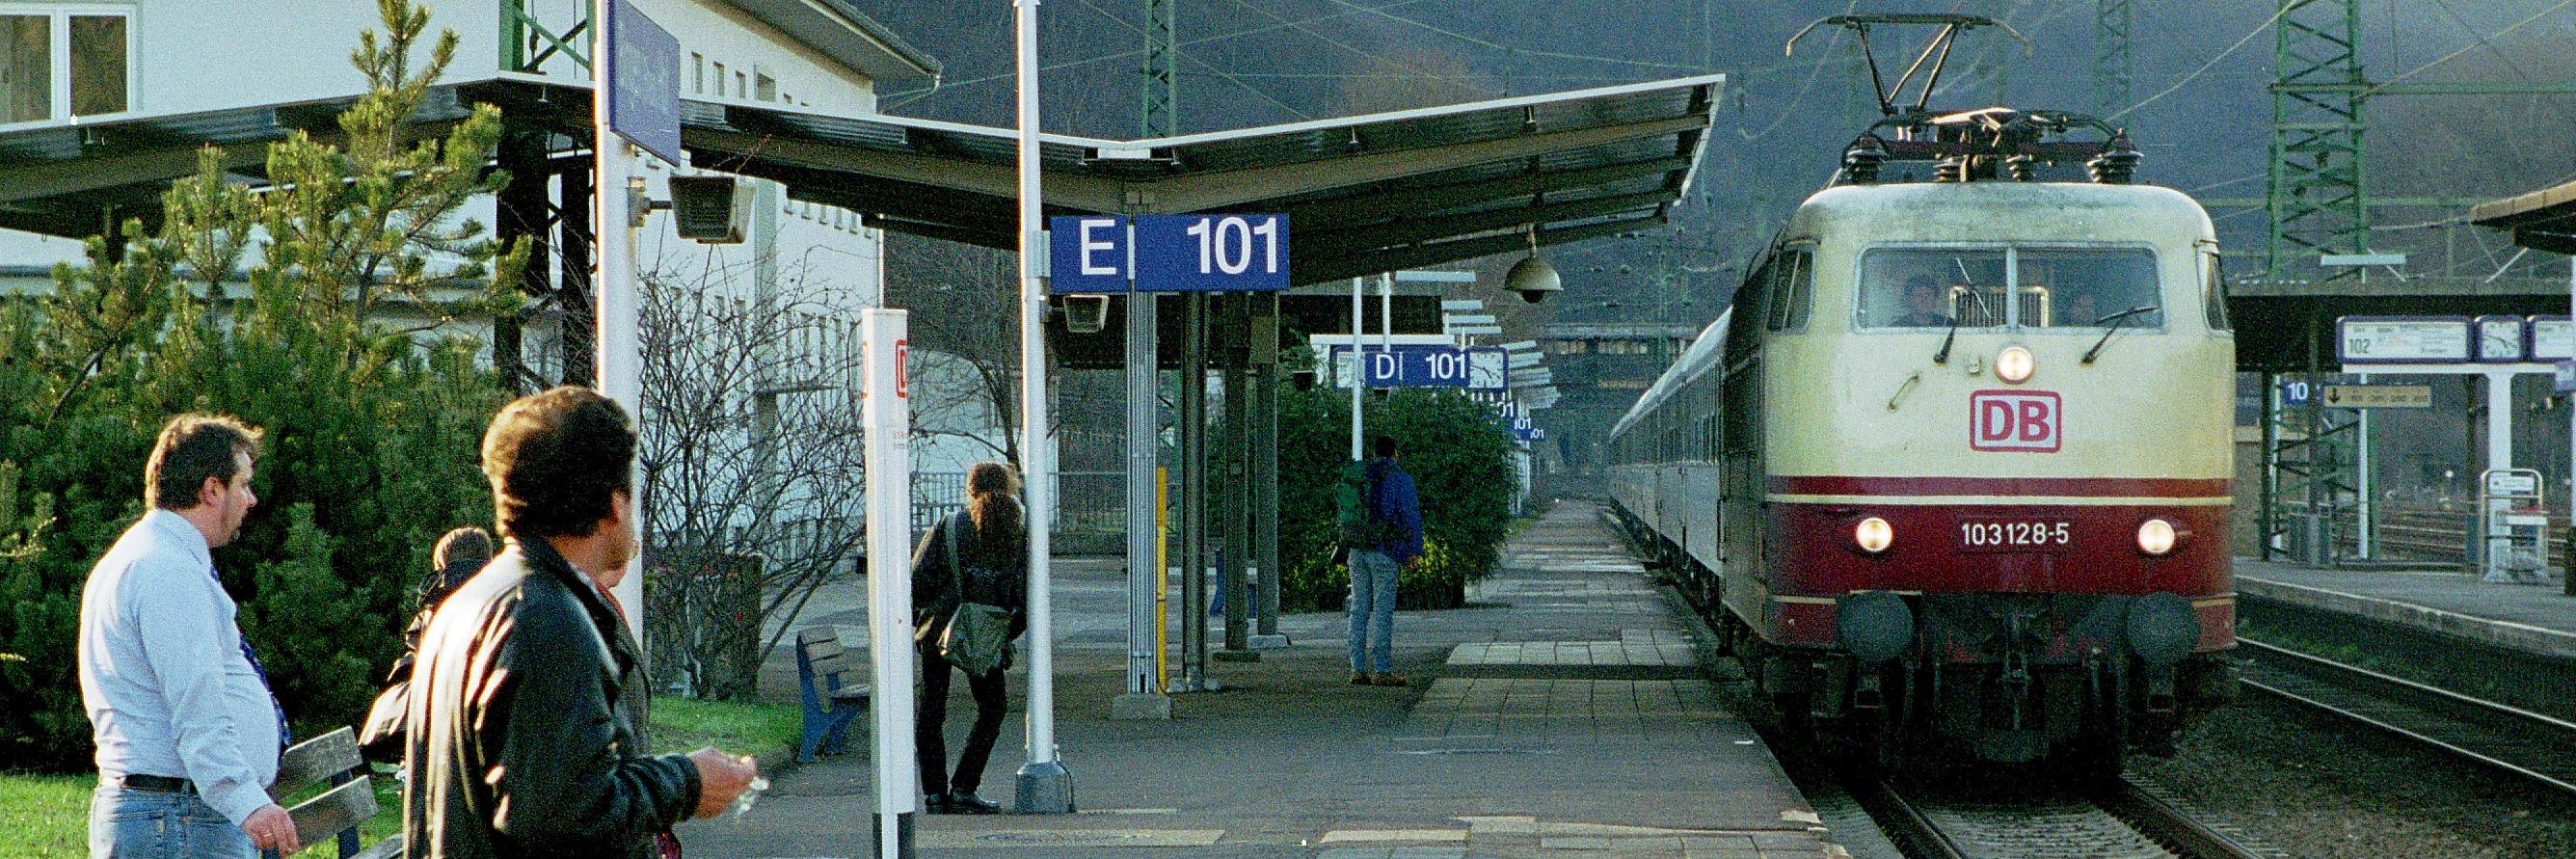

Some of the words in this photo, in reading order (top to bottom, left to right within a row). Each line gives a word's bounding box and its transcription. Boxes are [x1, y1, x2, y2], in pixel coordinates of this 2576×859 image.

[1081, 220, 1117, 275] E
[1187, 217, 1277, 274] 101
[2348, 338, 2371, 355] 102
[1376, 354, 1396, 380] D
[1425, 353, 1465, 379] 101
[2288, 382, 2320, 400] 10
[1982, 399, 2052, 442] DB
